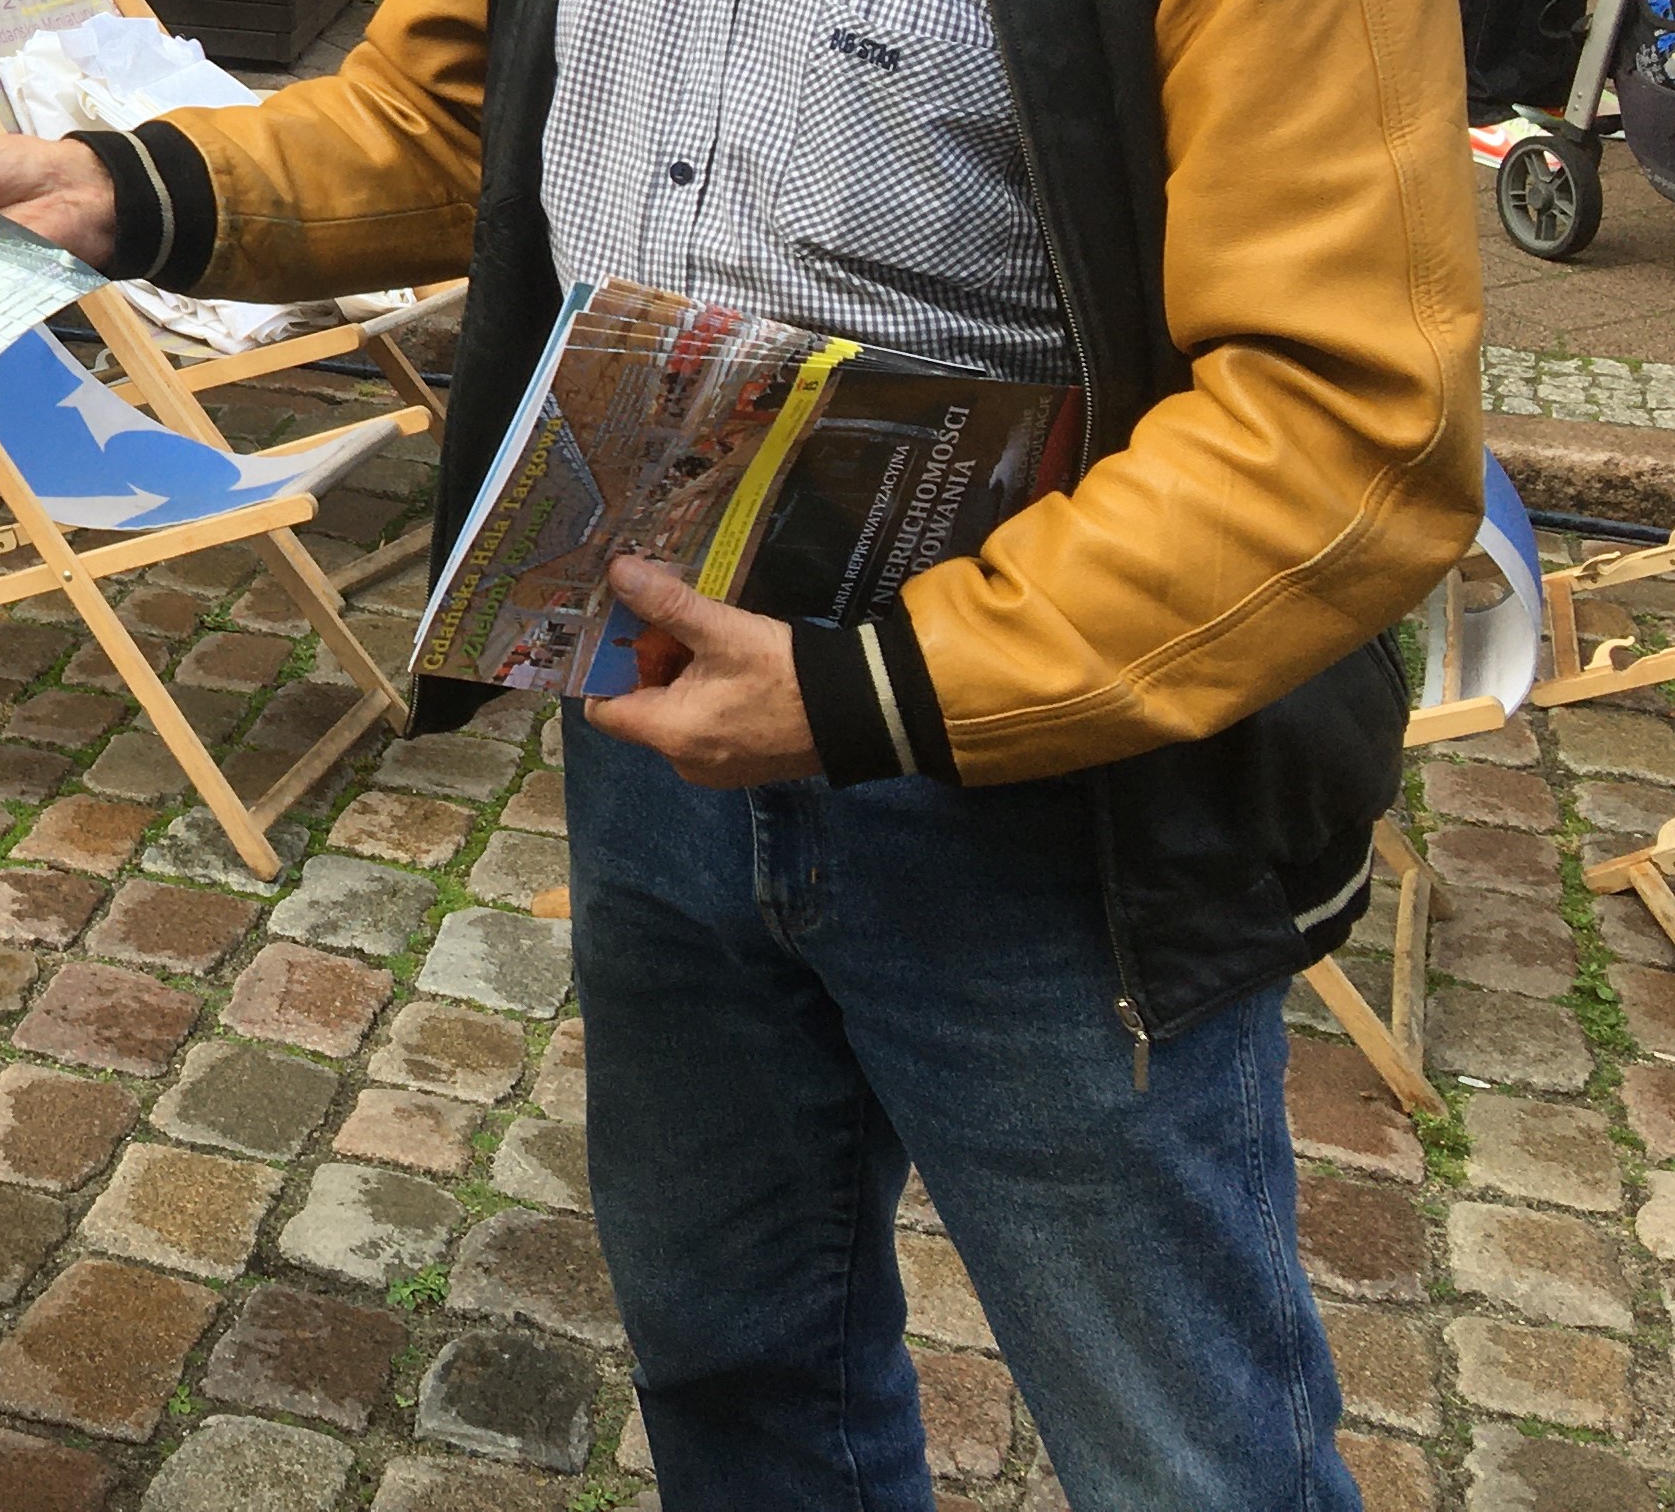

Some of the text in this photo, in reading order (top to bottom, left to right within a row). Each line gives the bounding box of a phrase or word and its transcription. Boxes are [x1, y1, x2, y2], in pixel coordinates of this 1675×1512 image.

[422, 416, 564, 671] Gdańska Hala Targowa
[844, 445, 910, 581] REPRYWATYZACYJNA
[872, 404, 971, 606] NIERUCHOMOŚCI
[461, 571, 517, 660] Zielony
